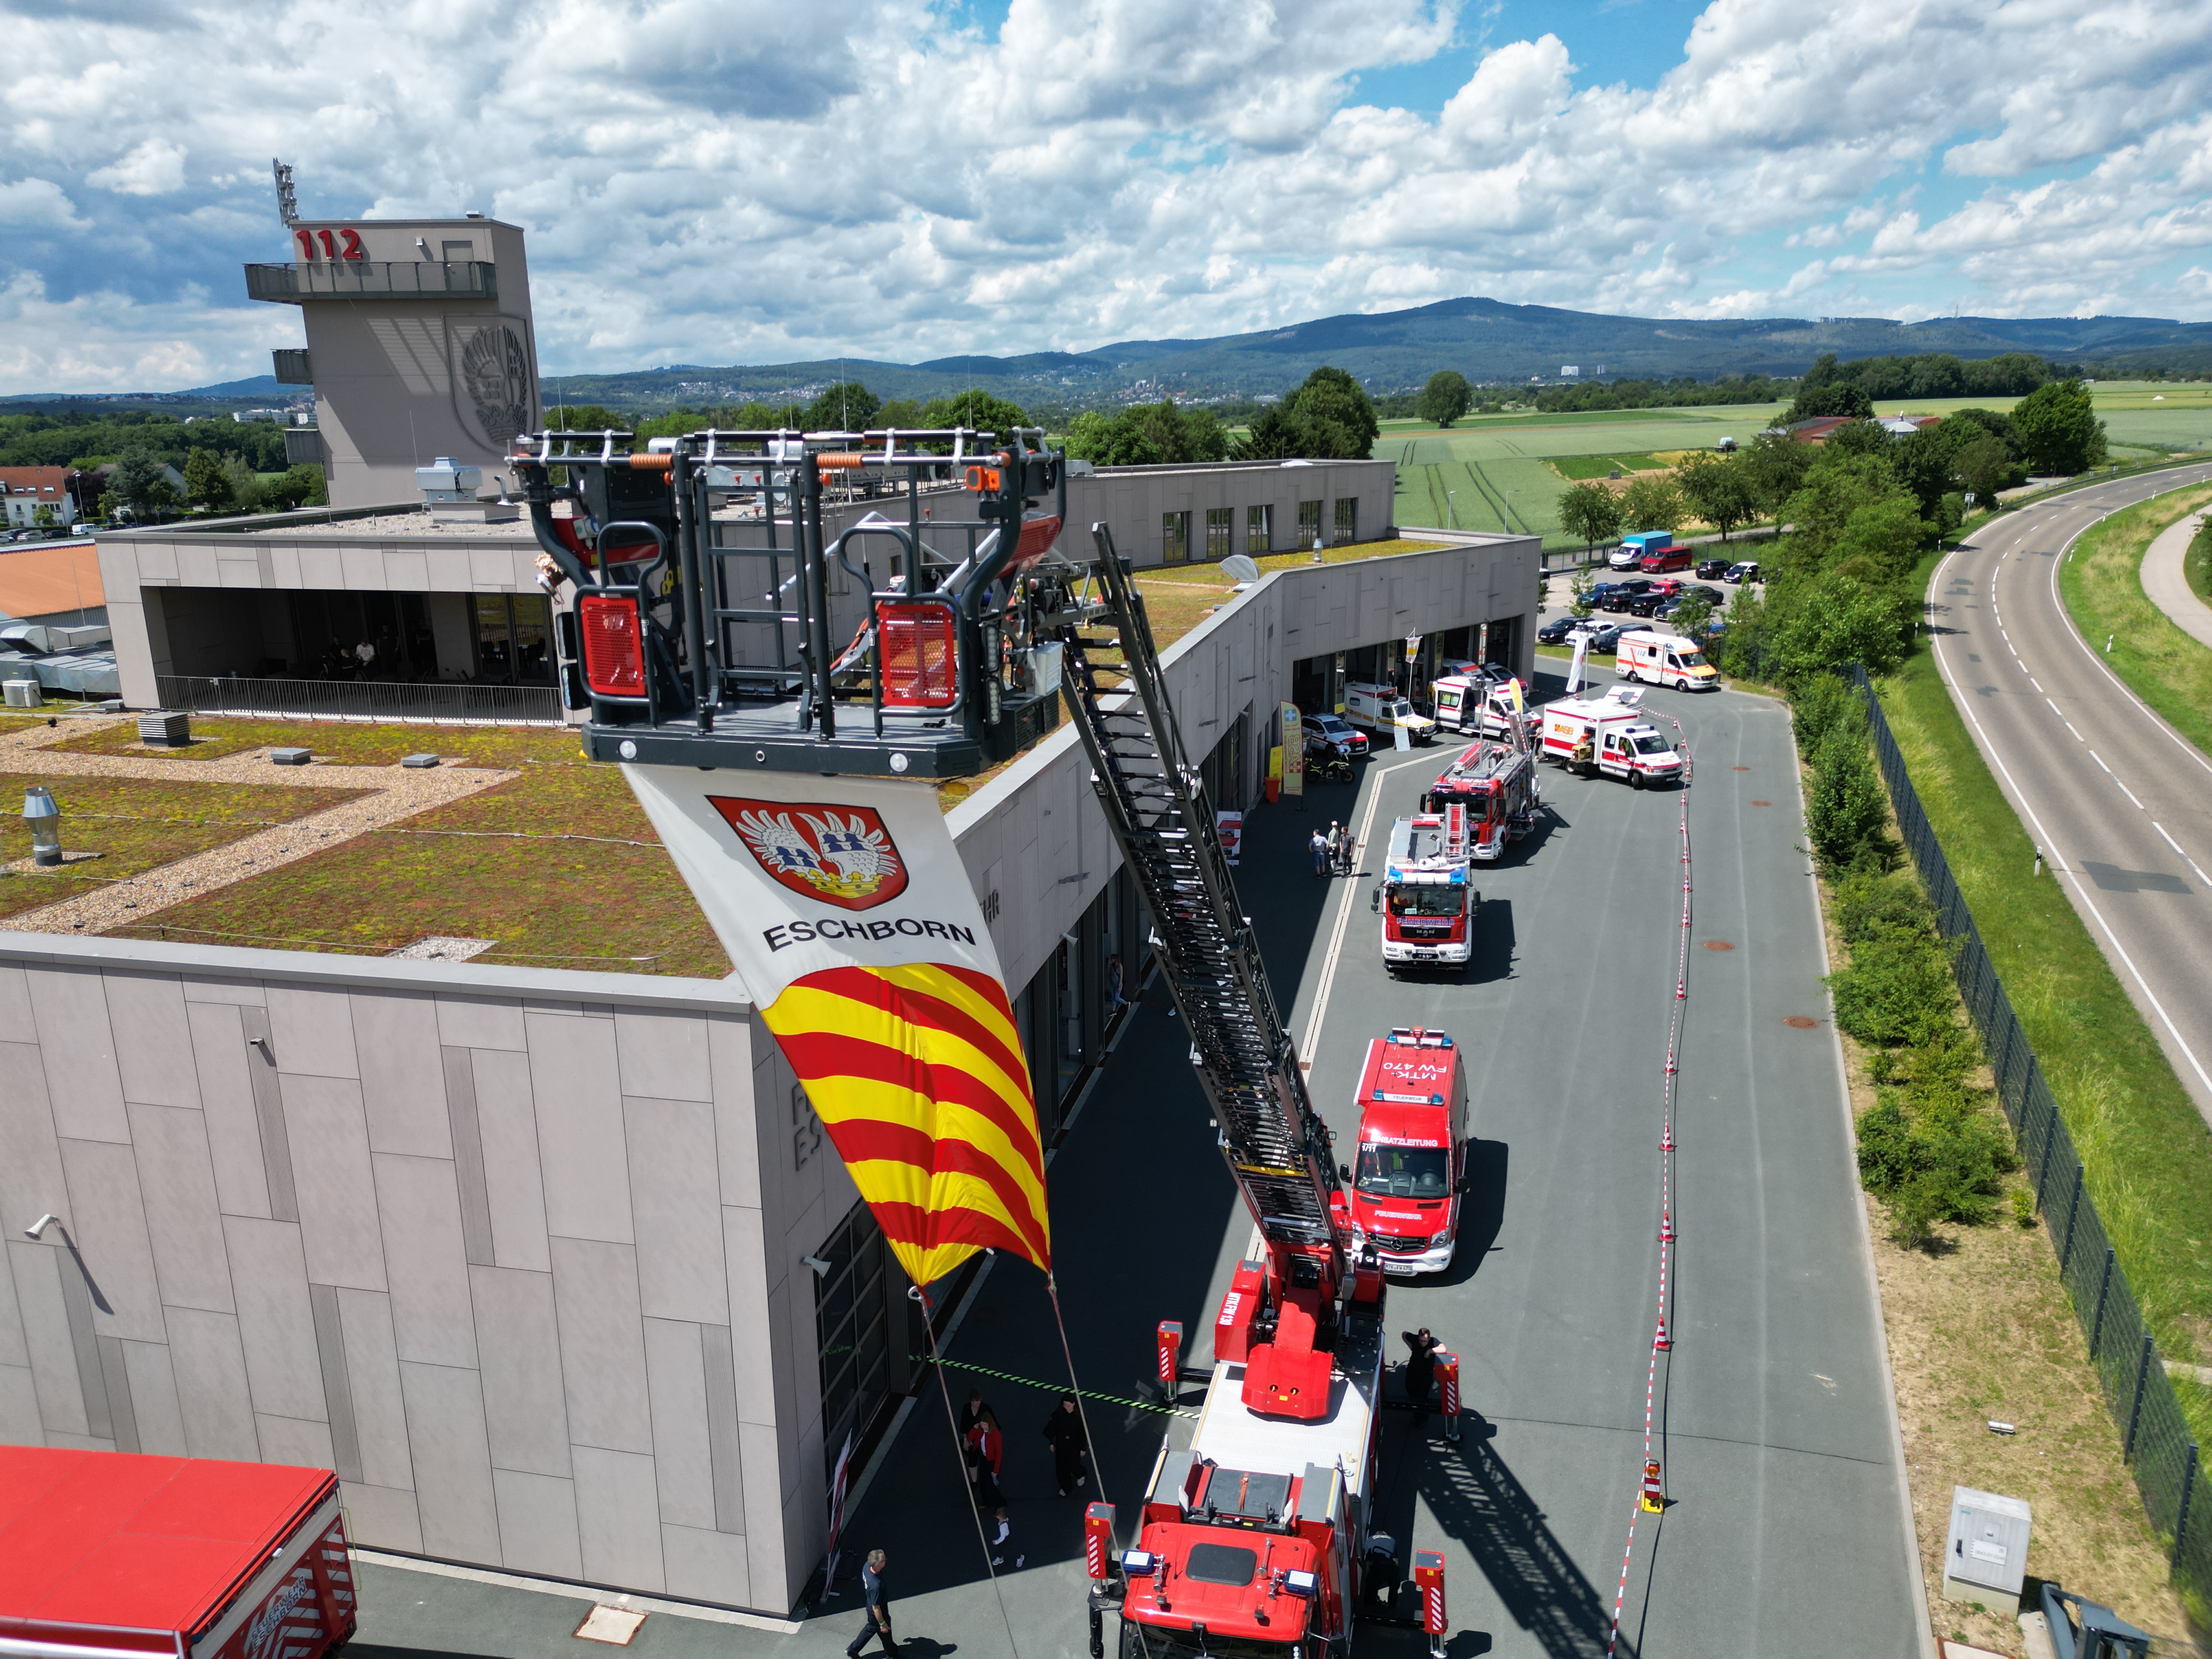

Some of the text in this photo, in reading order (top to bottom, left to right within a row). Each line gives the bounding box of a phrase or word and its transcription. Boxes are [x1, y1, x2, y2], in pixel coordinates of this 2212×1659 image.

[296, 229, 362, 259] 112
[763, 918, 977, 953] ESCHBORN
[1418, 1064, 1447, 1073] FW
[1370, 1135, 1438, 1147] EINSATZLEITUNG
[1374, 1210, 1423, 1220] FEUERWEHR
[252, 1576, 304, 1639] FEUERWEHR
[253, 1584, 306, 1649] ESCHBORN
